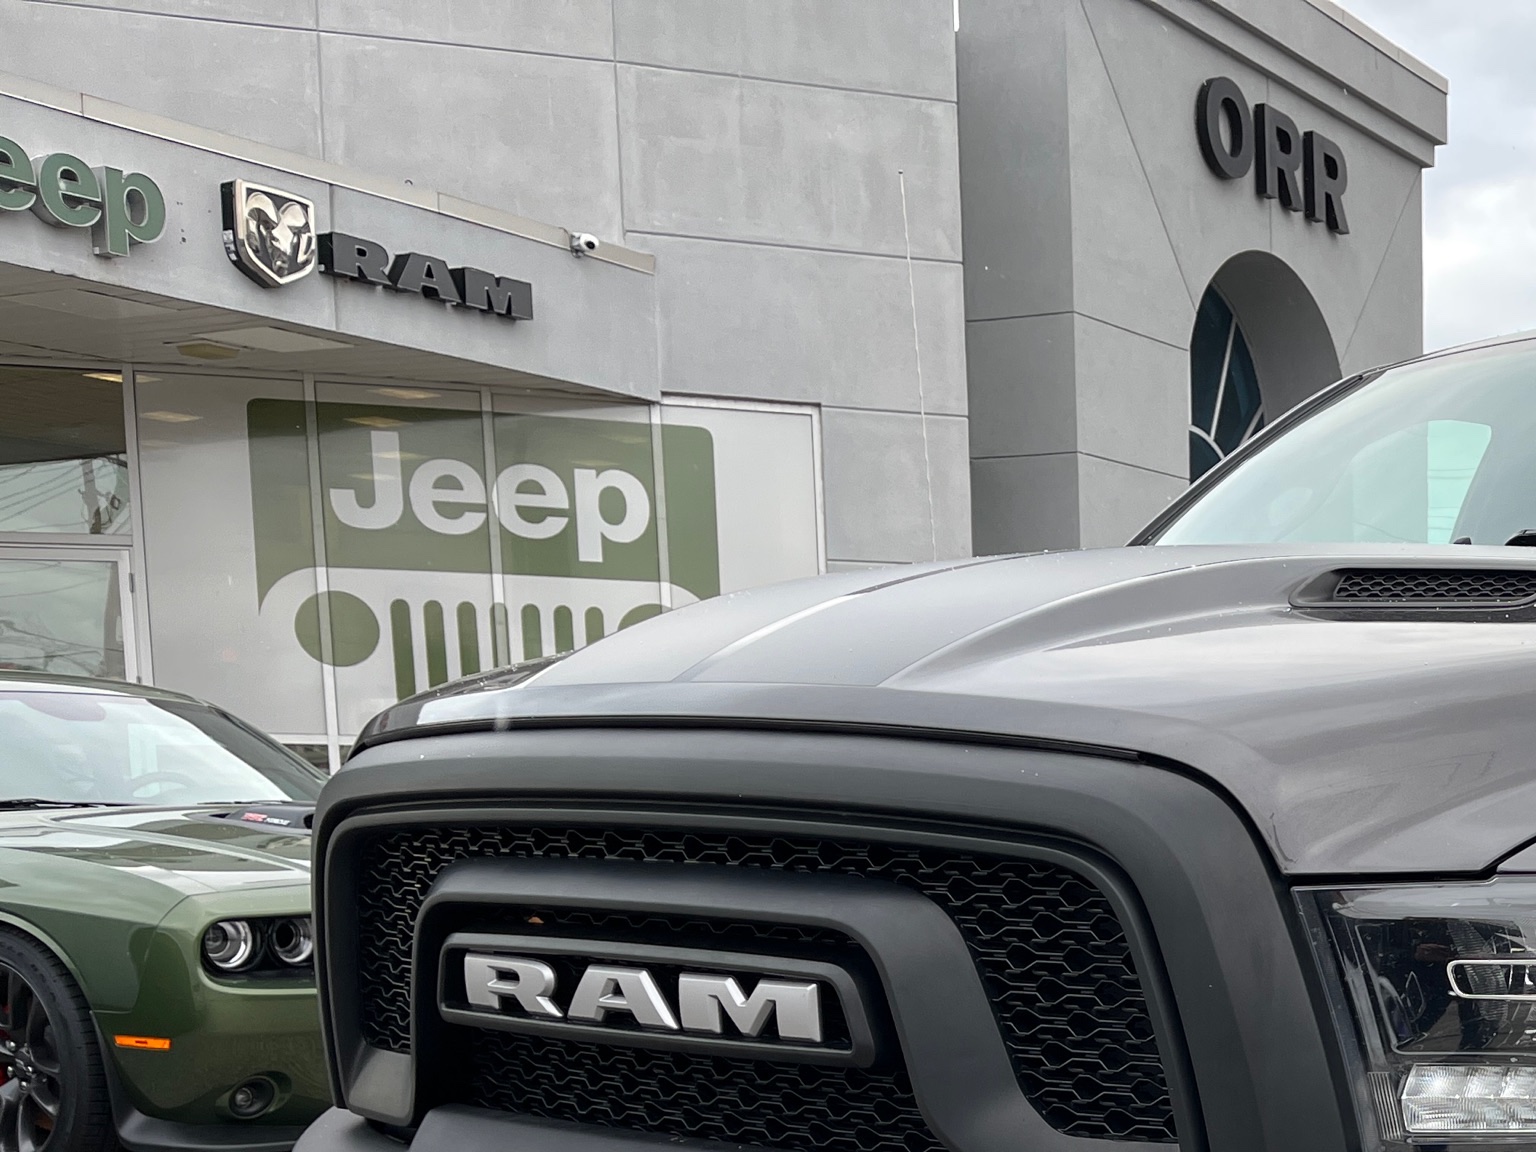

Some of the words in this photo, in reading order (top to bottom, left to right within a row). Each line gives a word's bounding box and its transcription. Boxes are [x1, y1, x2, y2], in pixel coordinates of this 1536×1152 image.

[1195, 76, 1350, 235] ORR
[316, 231, 533, 321] RAM
[329, 430, 651, 563] Jeep
[464, 952, 823, 1043] RAM
